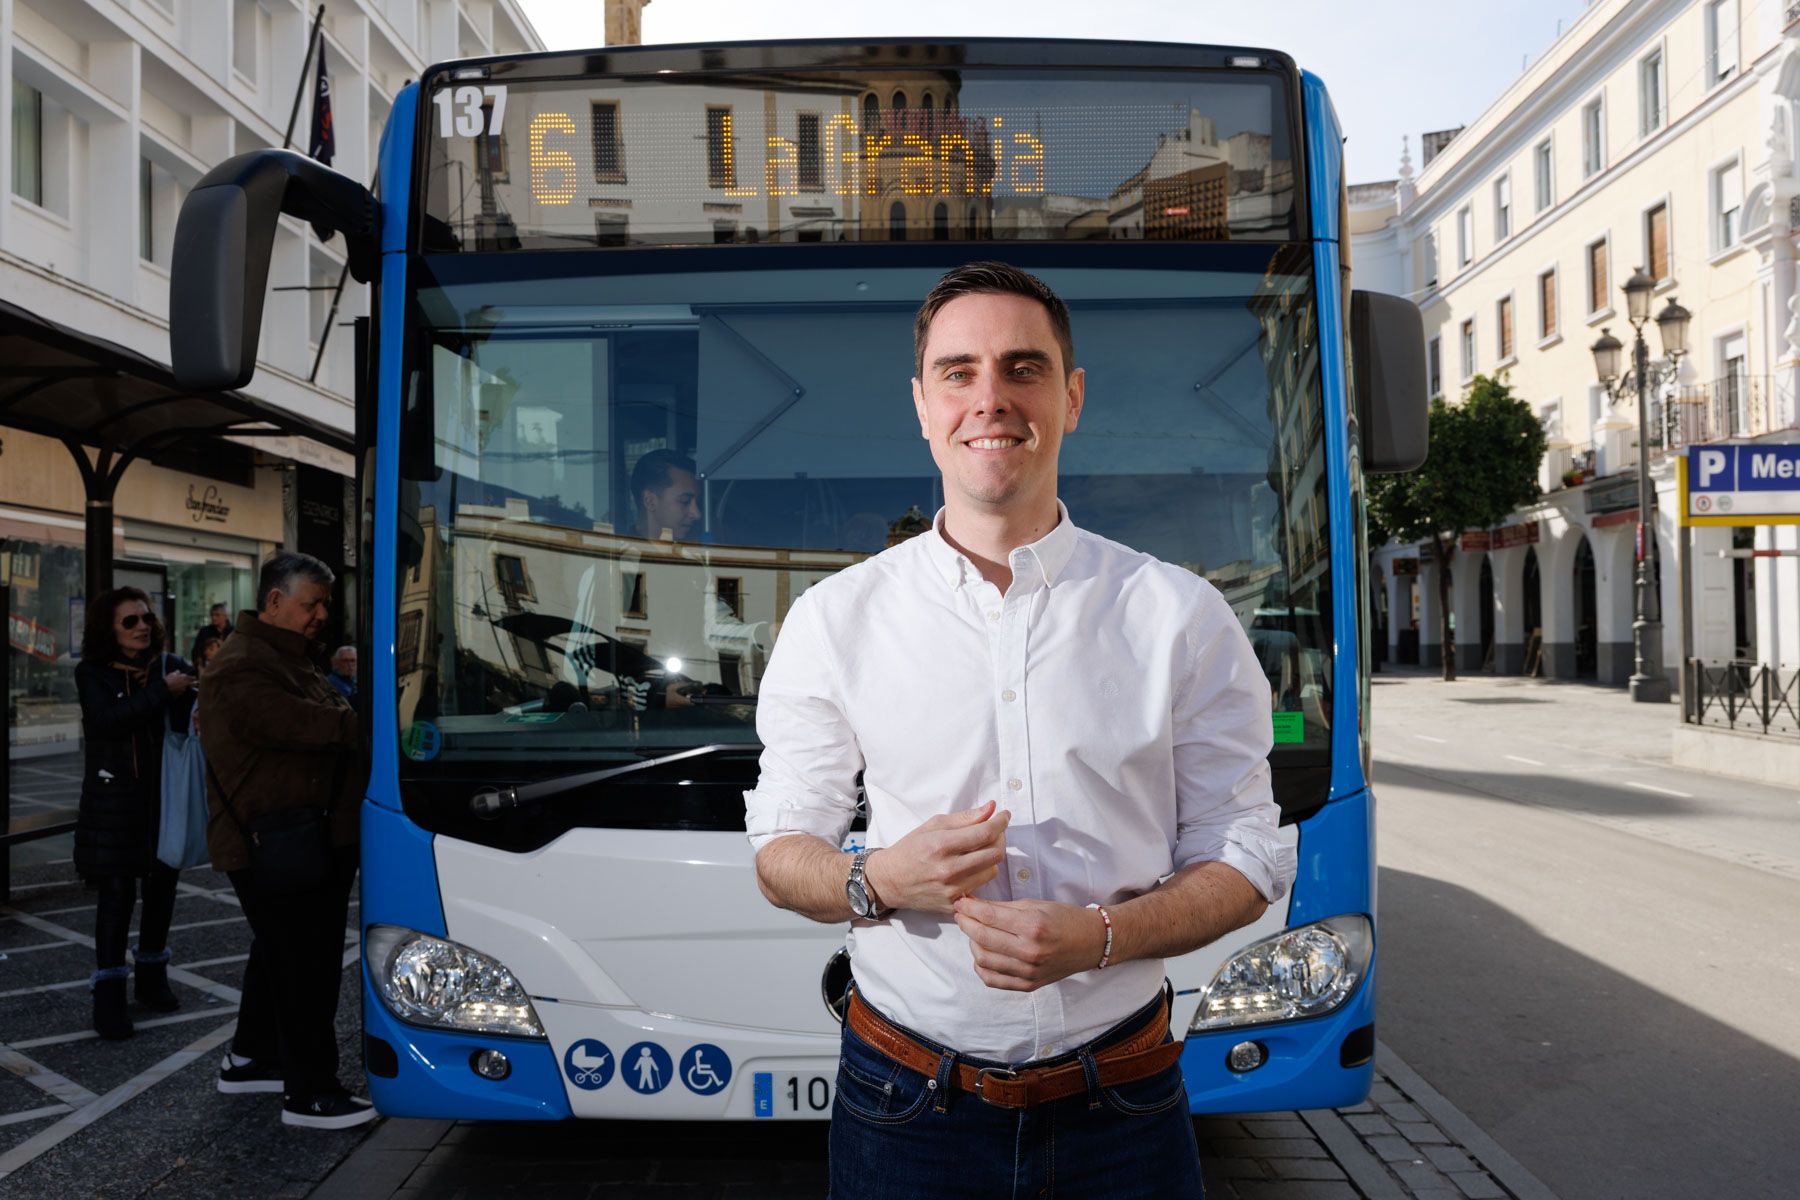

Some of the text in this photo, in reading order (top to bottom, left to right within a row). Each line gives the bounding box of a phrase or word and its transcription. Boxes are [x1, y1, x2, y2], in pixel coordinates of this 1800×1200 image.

[432, 86, 508, 138] 137
[529, 112, 1046, 206] 6 La Granja
[1699, 450, 1726, 488] P
[760, 1100, 768, 1110] E
